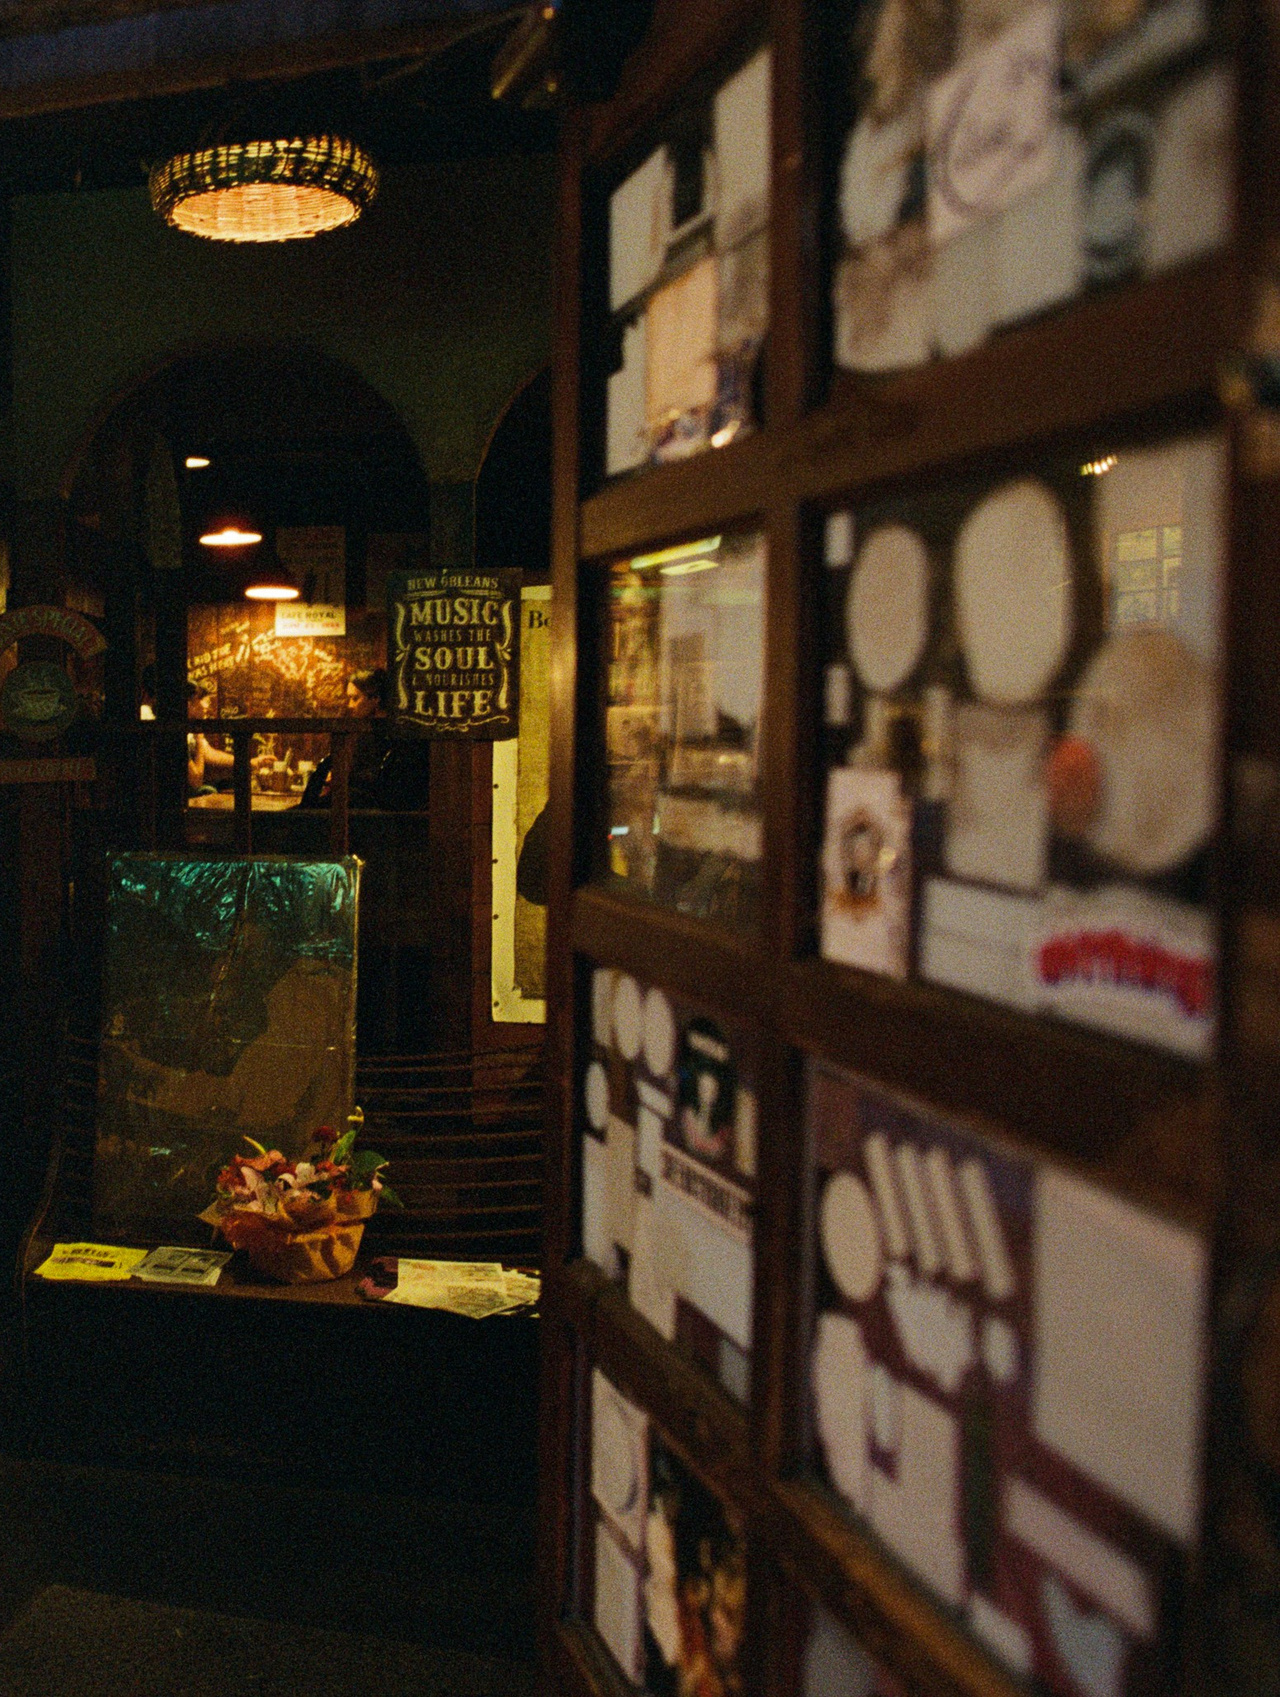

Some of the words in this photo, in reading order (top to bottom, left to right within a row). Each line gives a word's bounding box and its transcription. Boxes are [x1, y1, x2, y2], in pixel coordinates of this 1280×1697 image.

[408, 577, 436, 591] NEW
[441, 574, 499, 588] ORLEANS
[410, 597, 499, 626] MUSIC
[414, 629, 462, 642] WASHES
[470, 629, 492, 642] THE
[414, 646, 494, 670] SOUL
[426, 673, 494, 686] NOURISHES
[413, 690, 494, 718] LIFE
